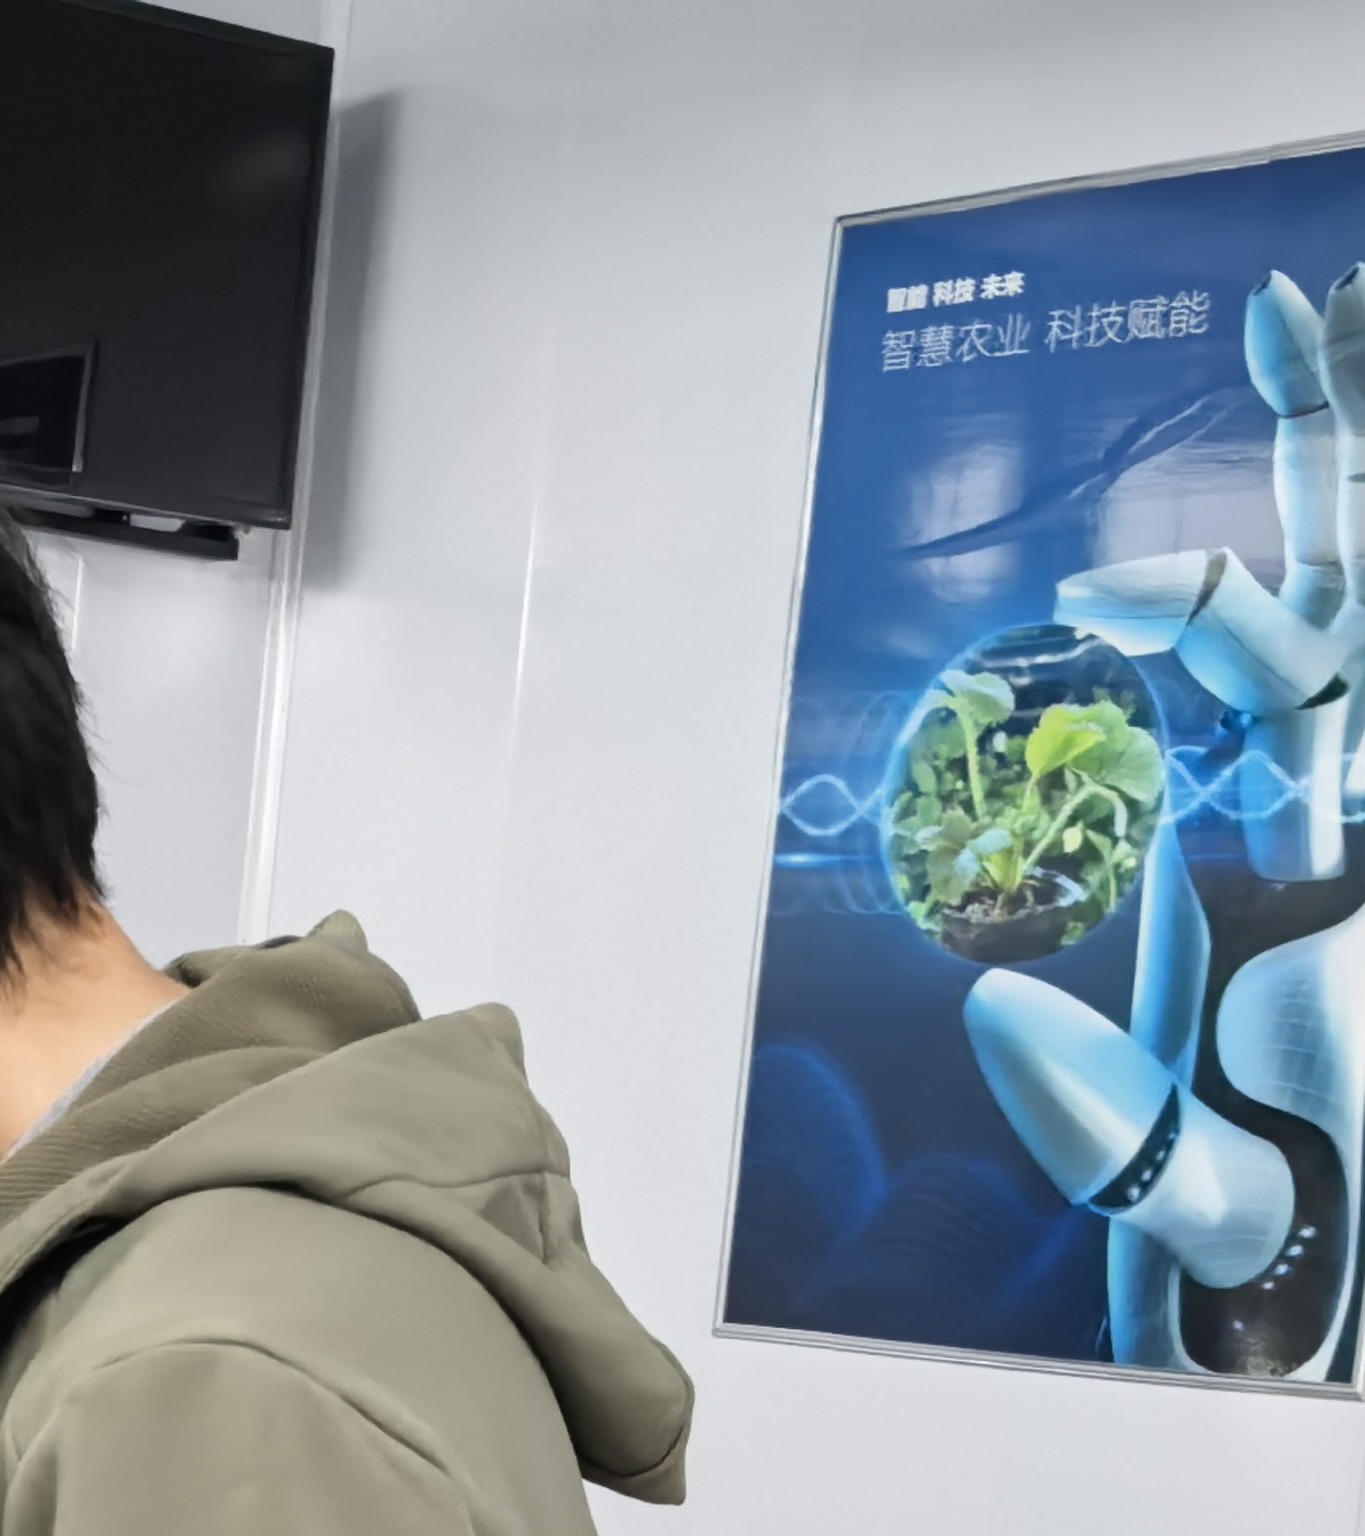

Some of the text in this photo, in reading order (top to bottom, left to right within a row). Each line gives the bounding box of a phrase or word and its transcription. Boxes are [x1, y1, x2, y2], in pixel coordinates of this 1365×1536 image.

[880, 289, 1211, 374] 智慧农业 科技赋能
